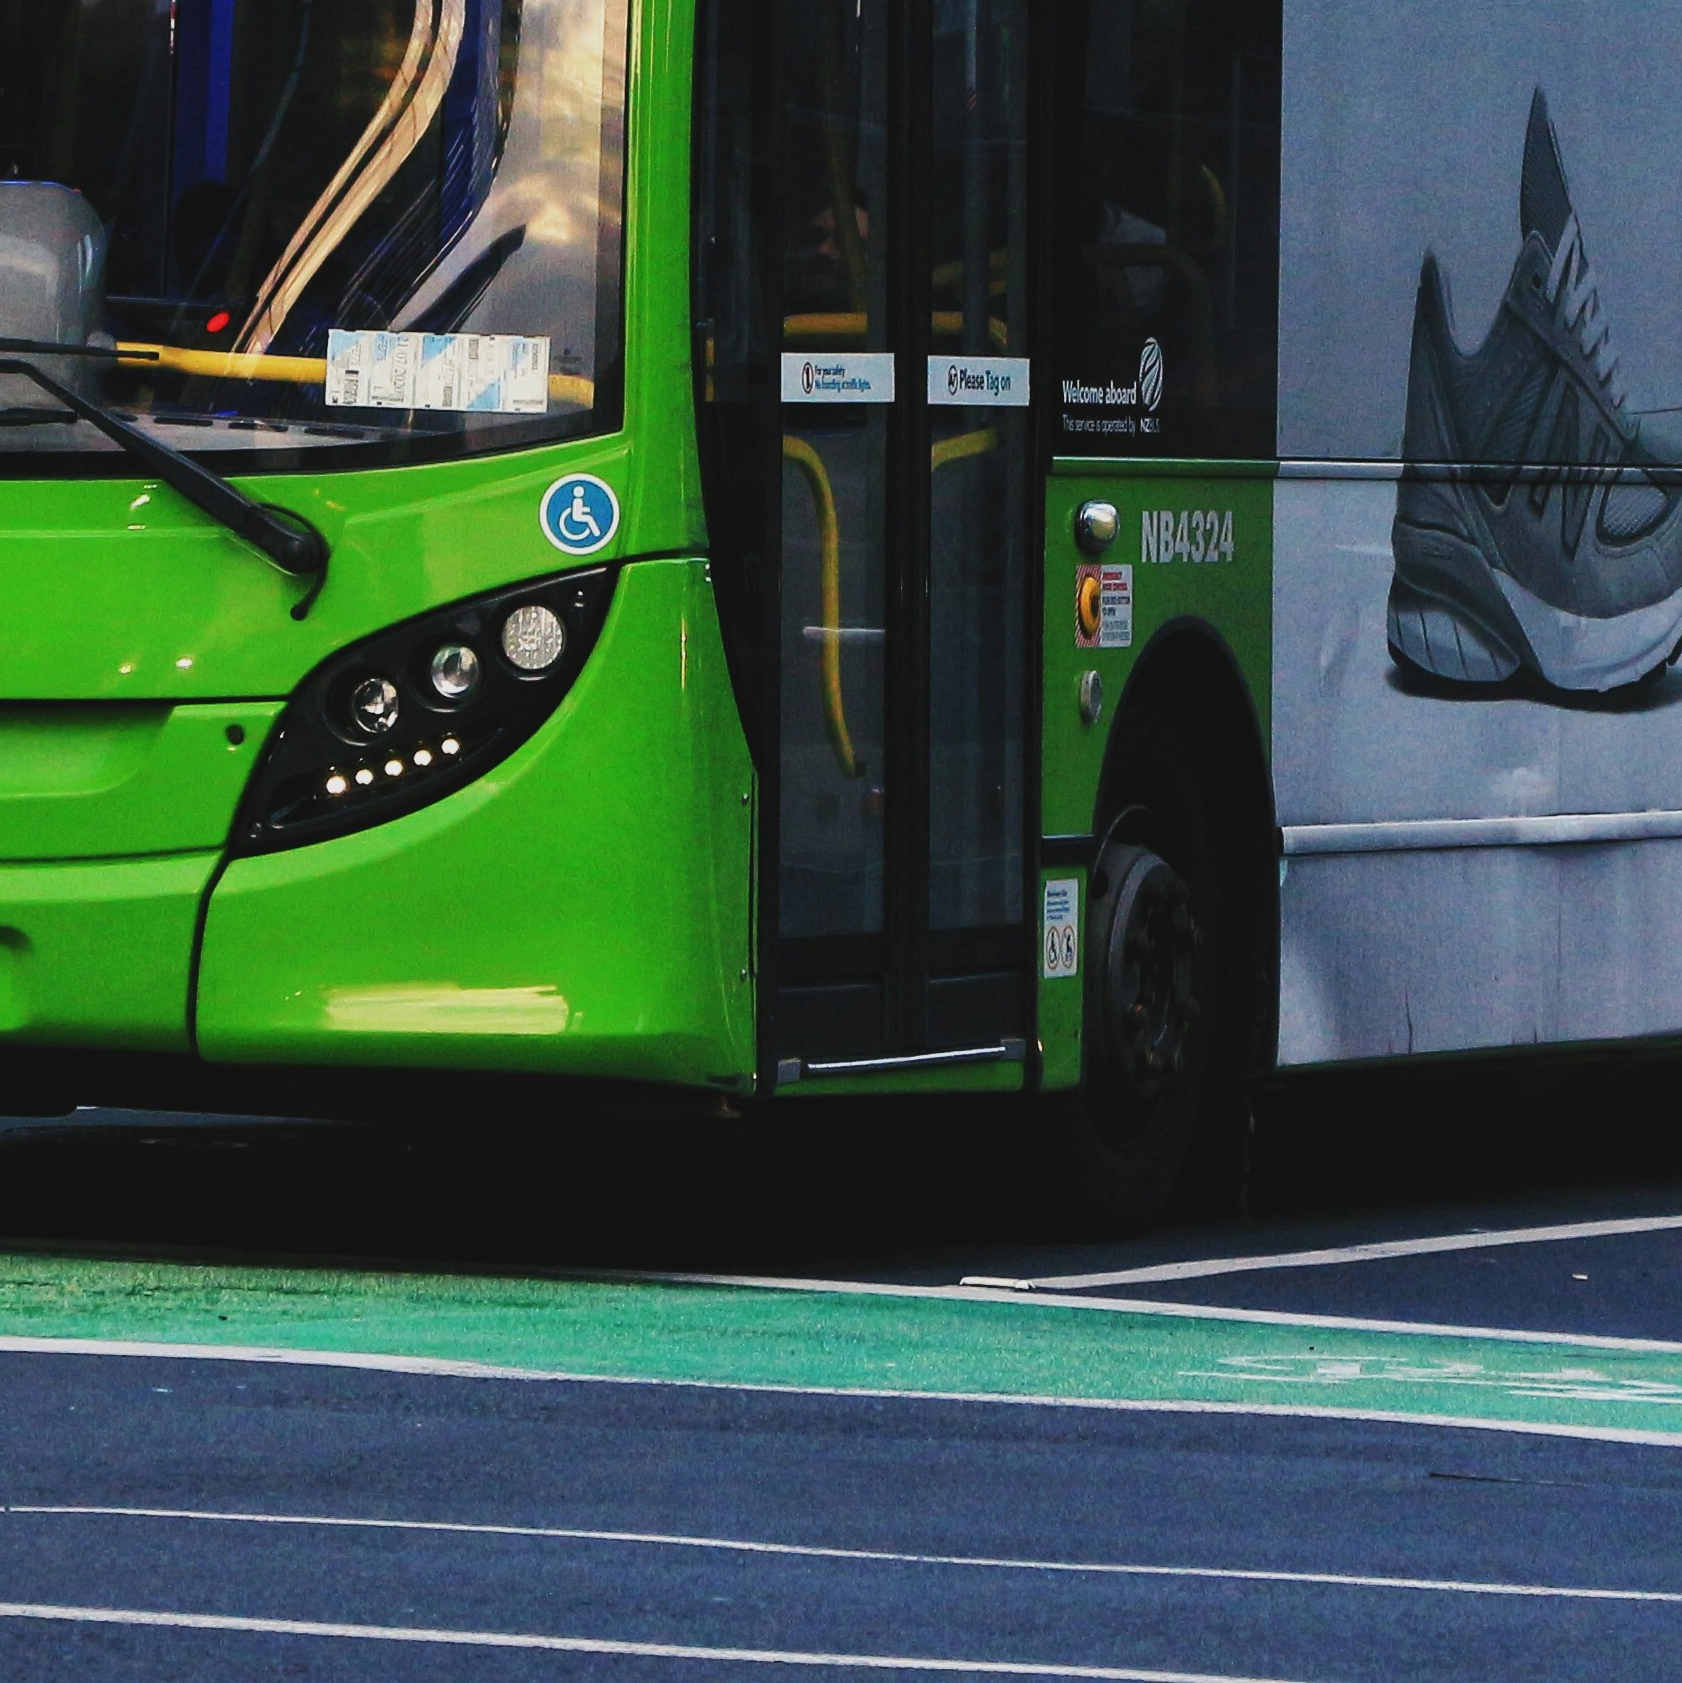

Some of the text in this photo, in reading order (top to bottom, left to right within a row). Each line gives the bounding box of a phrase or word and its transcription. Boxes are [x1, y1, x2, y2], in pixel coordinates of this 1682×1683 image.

[959, 368, 985, 391] Please
[985, 369, 1000, 396] Tag
[1000, 376, 1011, 391] on
[1062, 379, 1137, 405] Welcome aboard
[1062, 414, 1075, 431] This
[1075, 418, 1095, 432] service
[1096, 417, 1101, 432] is
[1101, 416, 1128, 436] operated
[1128, 415, 1136, 437] by
[1141, 509, 1235, 564] NB4324
